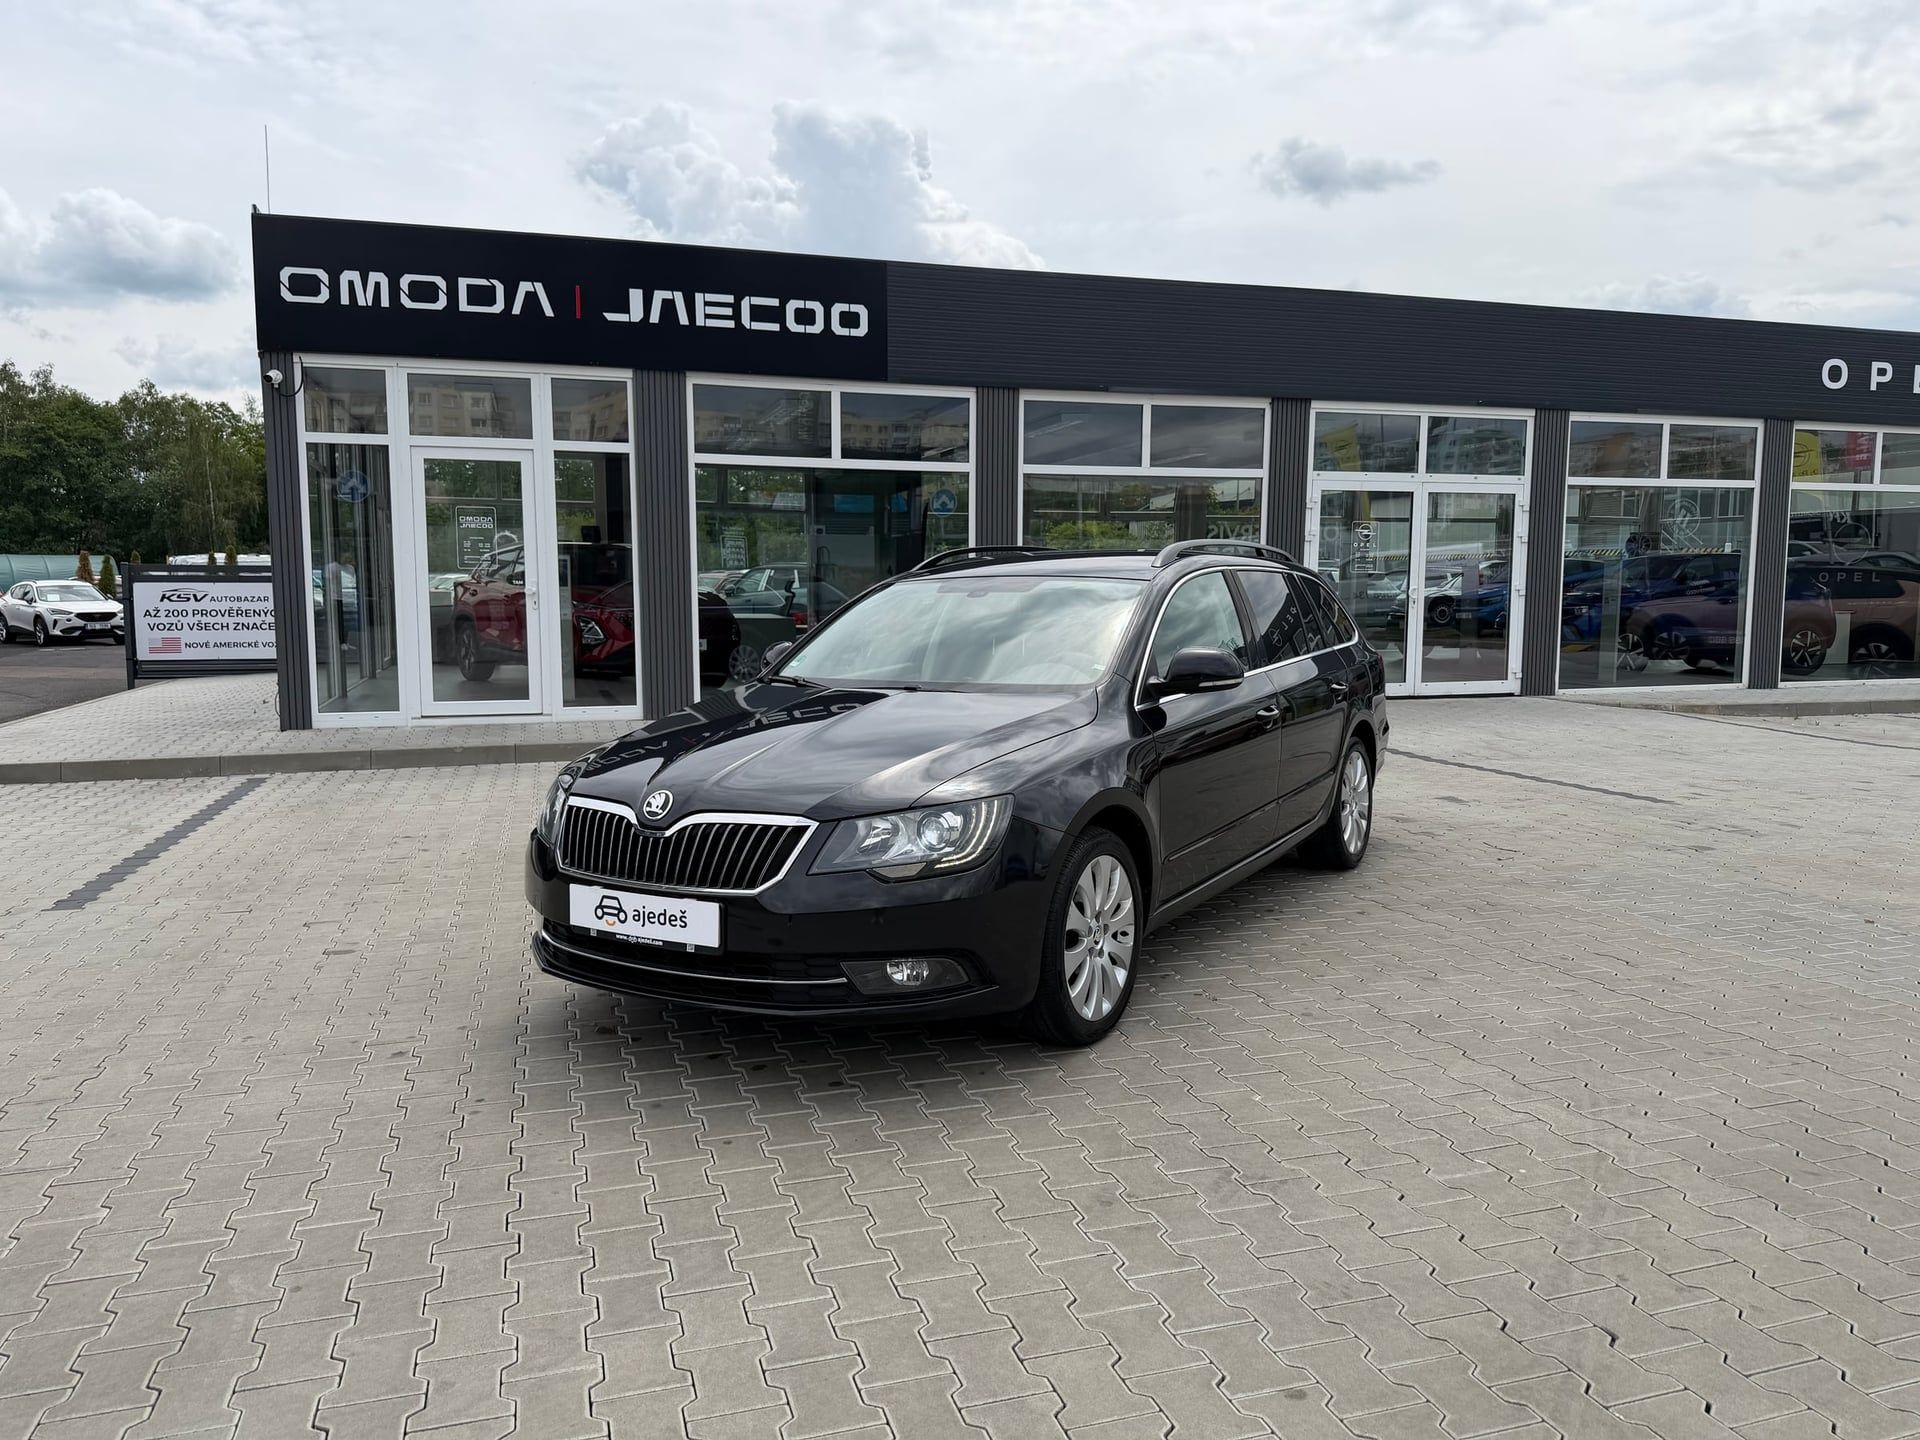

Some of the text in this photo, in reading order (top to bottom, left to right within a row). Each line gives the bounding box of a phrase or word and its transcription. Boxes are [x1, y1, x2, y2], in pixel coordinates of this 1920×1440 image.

[279, 265, 869, 337] OMODA JAECOO
[1818, 571, 1881, 583] OPEL
[160, 593, 270, 603] KSV AUTOBAZAR
[143, 606, 162, 618] AŽ
[164, 608, 189, 618] 200
[147, 619, 184, 632] VOZŮ
[187, 619, 229, 631] VŠECH
[184, 640, 211, 649] NOVÉ
[213, 639, 259, 649] AMERICKÉ
[632, 905, 687, 929] ajedeš
